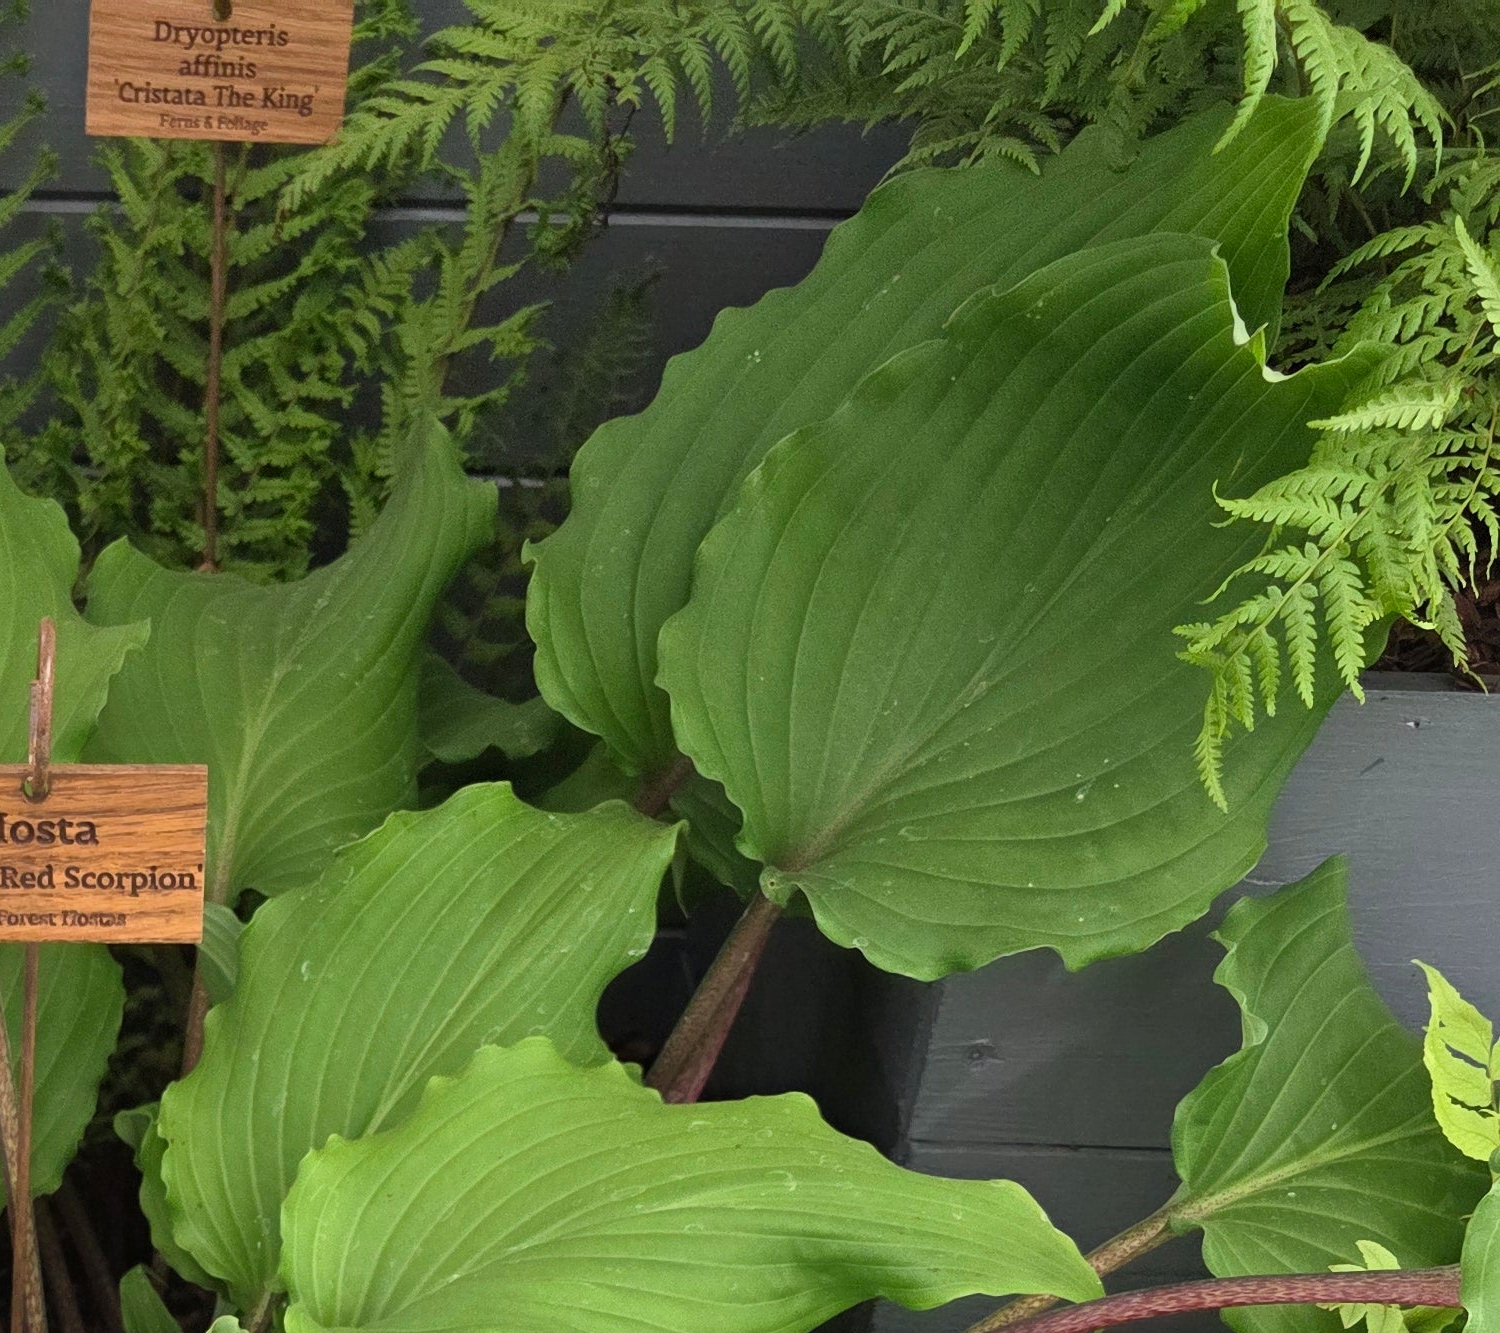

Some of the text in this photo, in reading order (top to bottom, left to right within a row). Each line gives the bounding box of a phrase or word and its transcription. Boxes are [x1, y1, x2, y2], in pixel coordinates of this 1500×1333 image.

[153, 20, 290, 50] Dryopteris
[179, 54, 257, 79] affinis
[114, 78, 320, 117] 'Cristata The King'
[159, 113, 269, 135] Ferns & Foliage
[0, 863, 56, 890] Red
[63, 862, 204, 897] Scorpion'
[61, 909, 127, 927] Hostas
